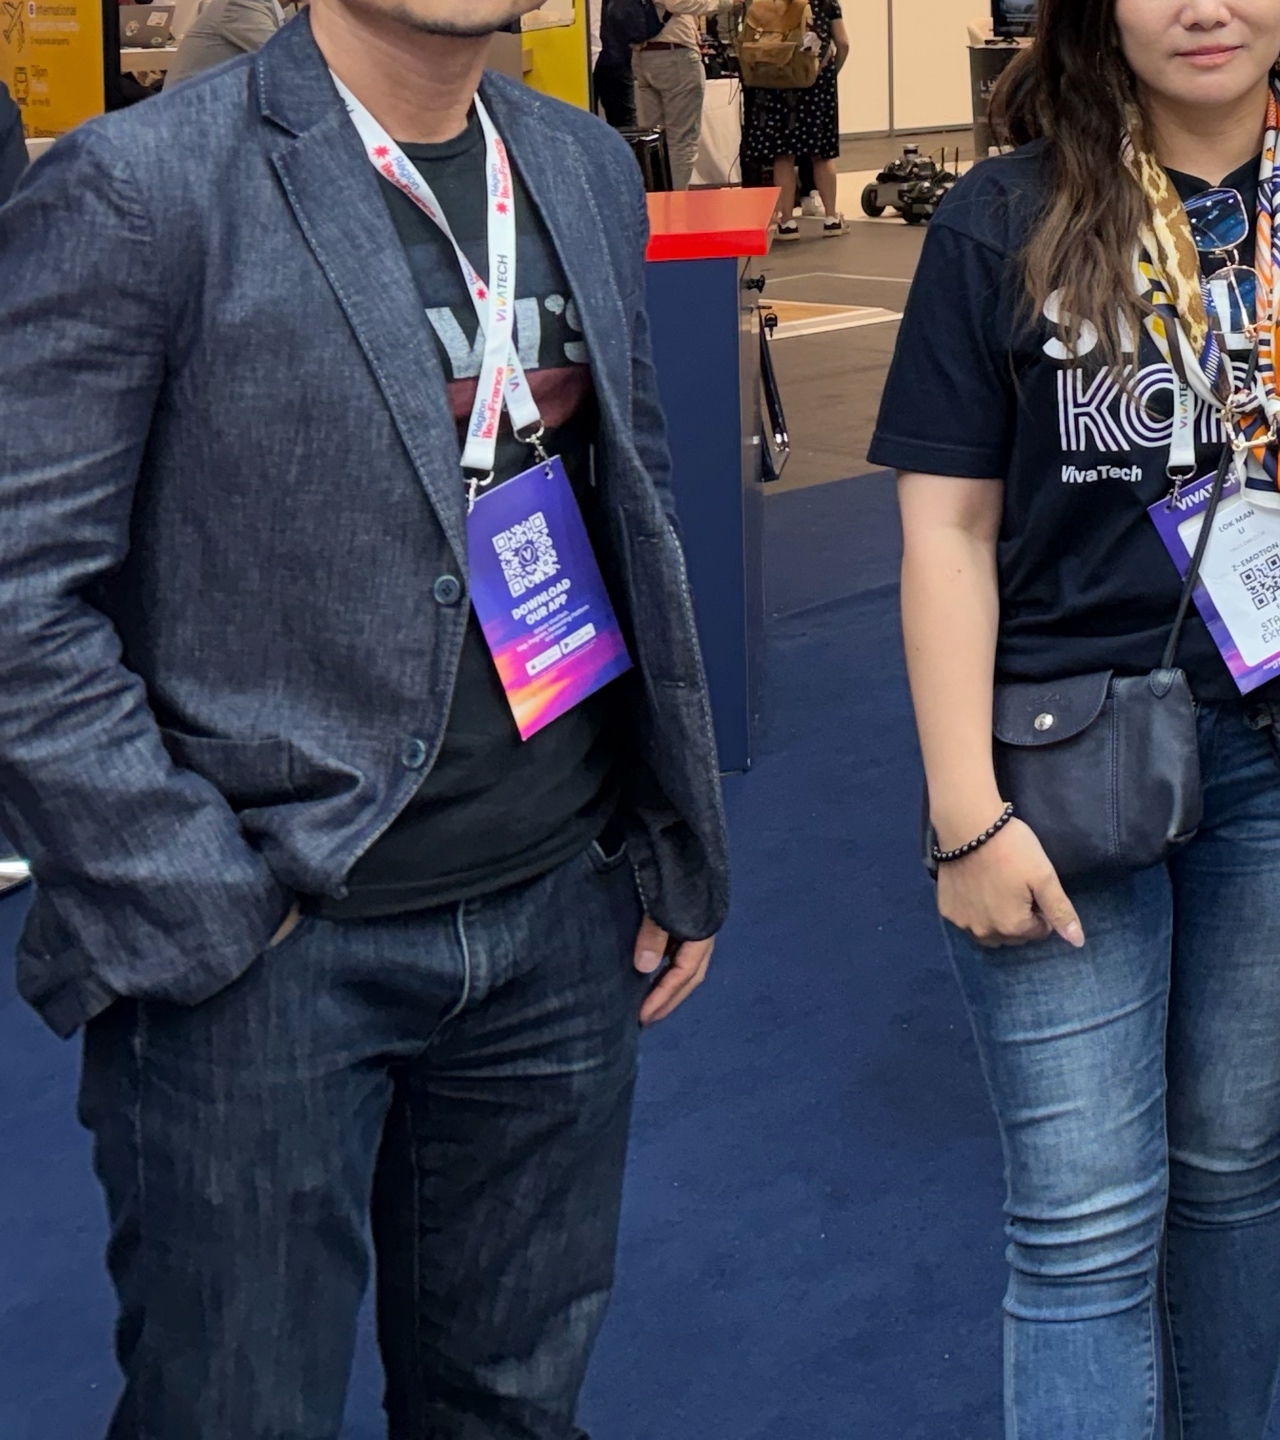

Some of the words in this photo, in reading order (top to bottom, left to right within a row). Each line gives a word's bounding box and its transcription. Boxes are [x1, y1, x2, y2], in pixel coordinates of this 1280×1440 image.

[496, 253, 509, 323] VIVATECH
[1061, 464, 1142, 484] VivaTech
[1176, 471, 1240, 511] VIVATCH
[1218, 518, 1235, 533] LOK
[1235, 509, 1256, 525] MAN
[1231, 542, 1280, 572] Z-EMOTION
[511, 578, 571, 621] DOWNLOAD
[525, 604, 549, 625] OUR
[548, 593, 568, 613] APP
